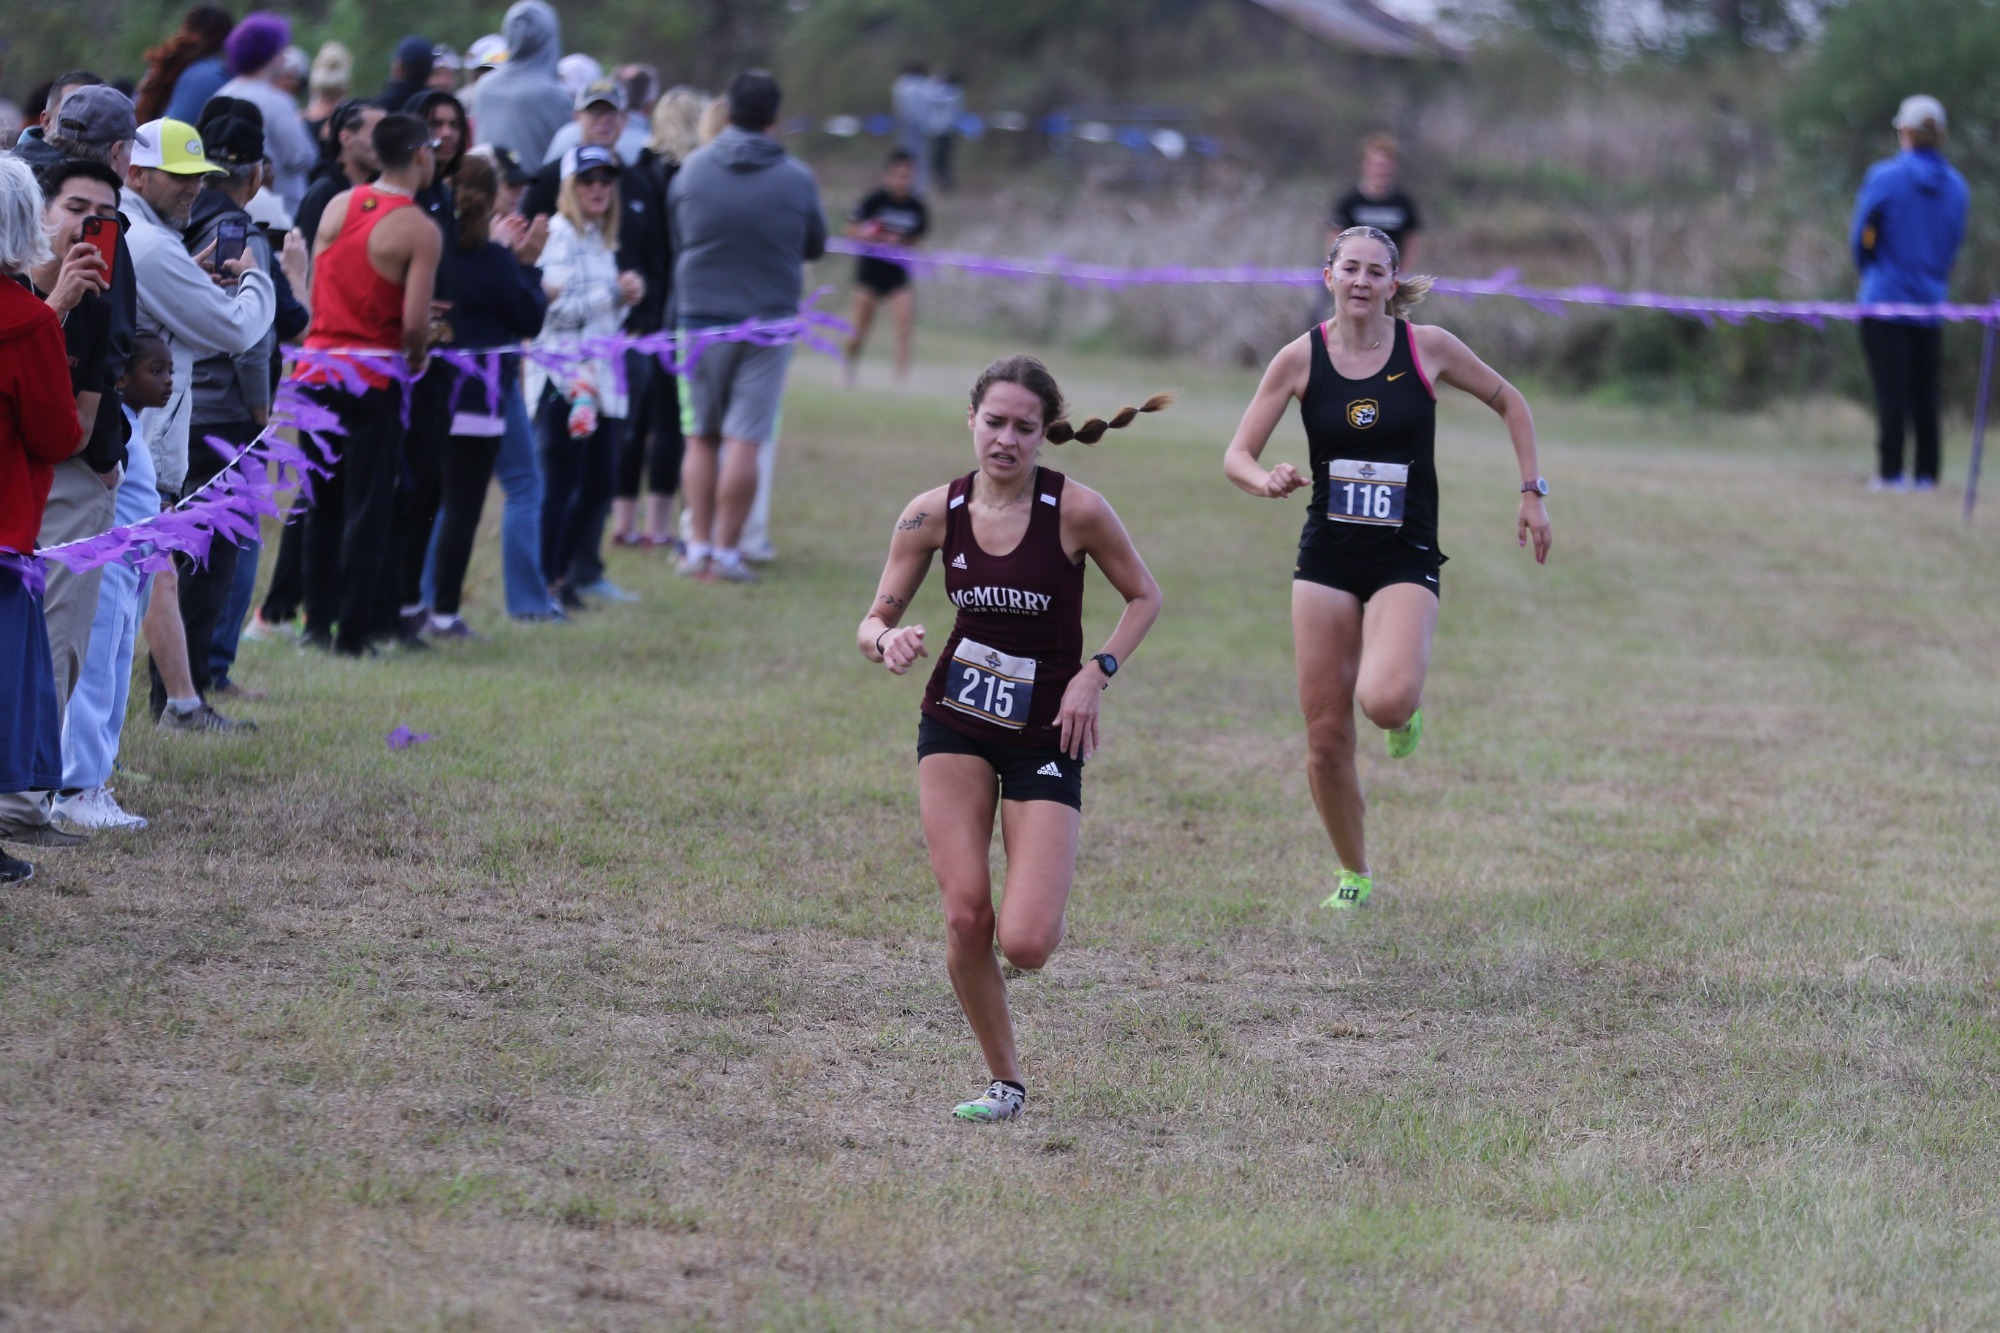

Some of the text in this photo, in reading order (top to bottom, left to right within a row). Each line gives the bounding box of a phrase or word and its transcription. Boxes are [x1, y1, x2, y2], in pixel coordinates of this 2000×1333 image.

[1343, 482, 1392, 519] 116
[958, 667, 1016, 718] 215
[1036, 769, 1063, 778] adidas
